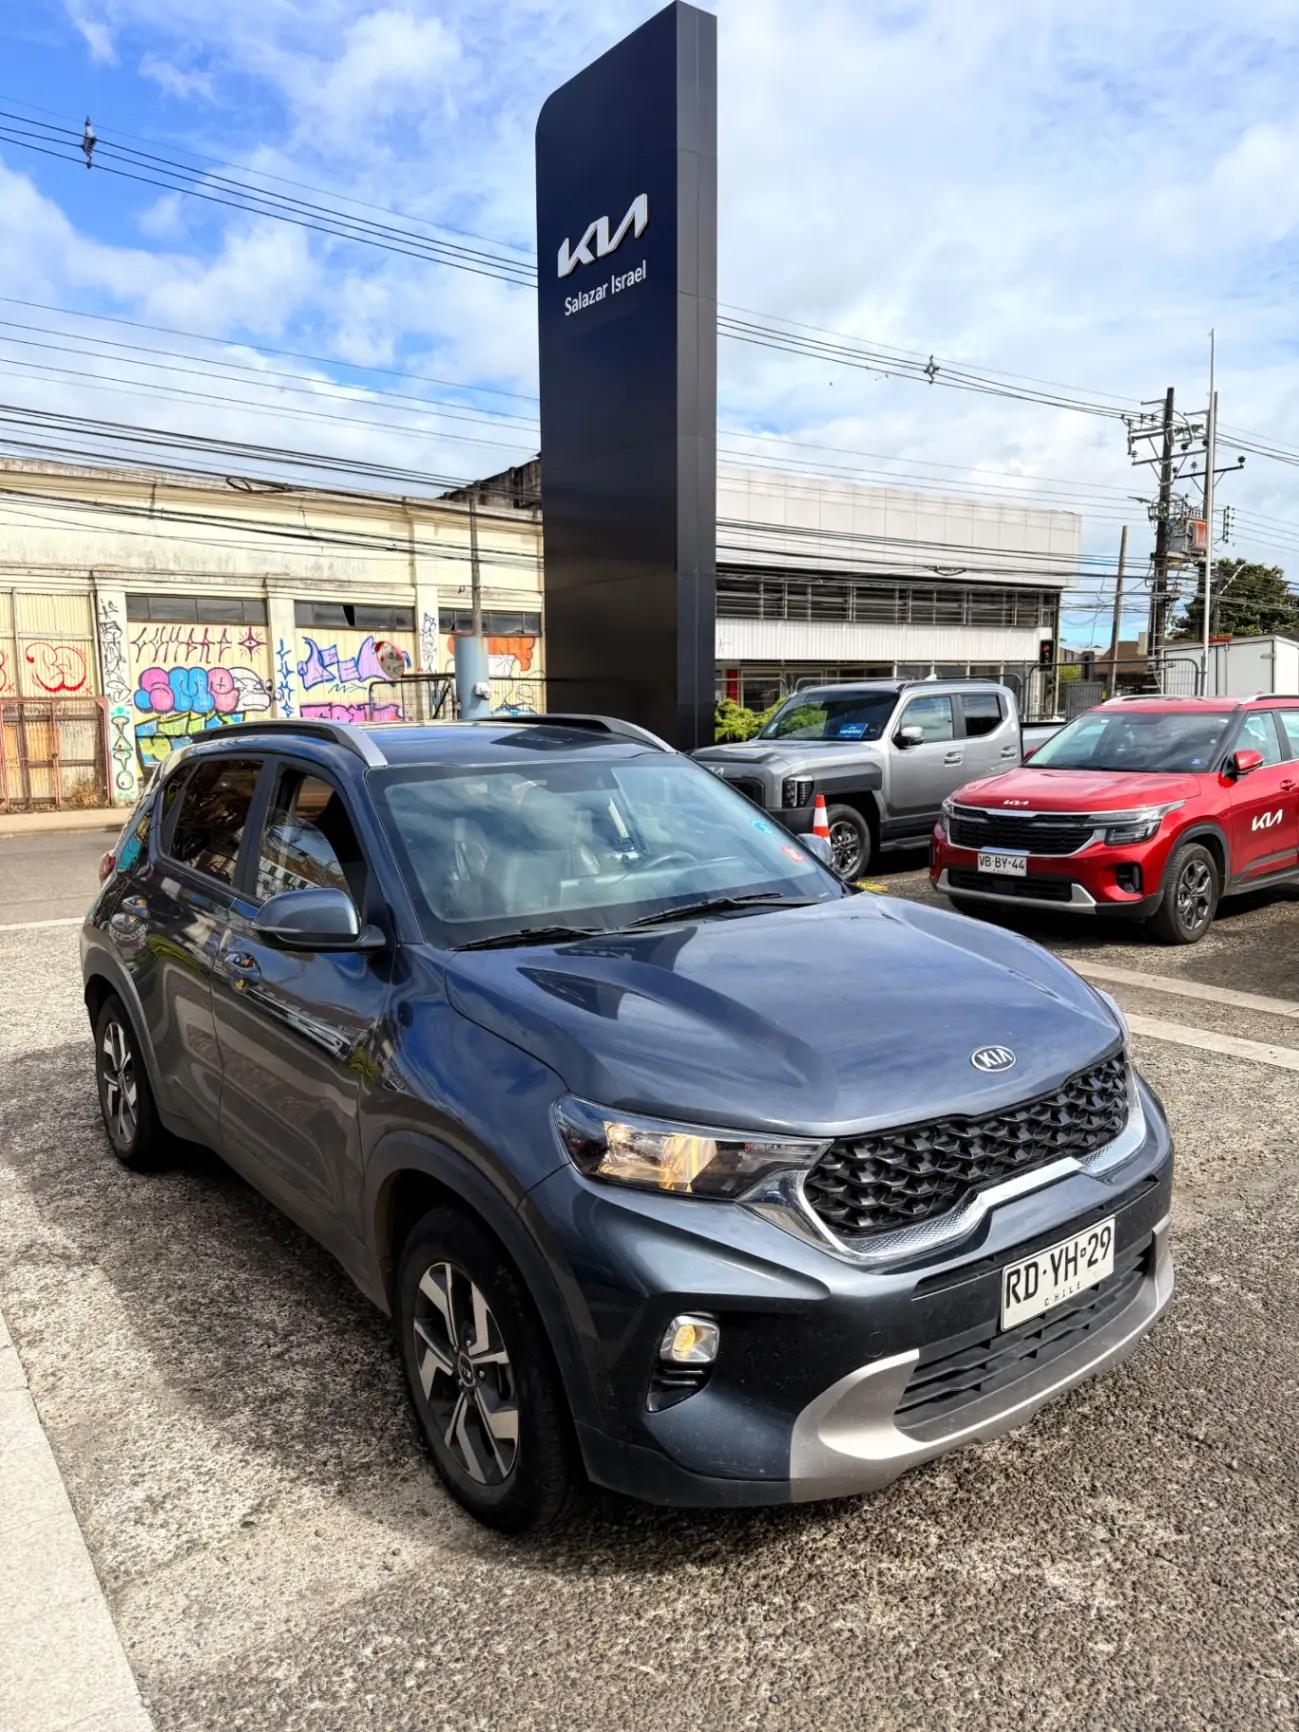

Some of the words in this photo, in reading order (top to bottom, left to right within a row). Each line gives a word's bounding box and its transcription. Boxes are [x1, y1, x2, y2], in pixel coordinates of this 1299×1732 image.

[564, 282, 609, 316] Salazar
[611, 259, 647, 295] Israel
[976, 1048, 1013, 1067] KIA
[1044, 1281, 1081, 1306] CHILE
